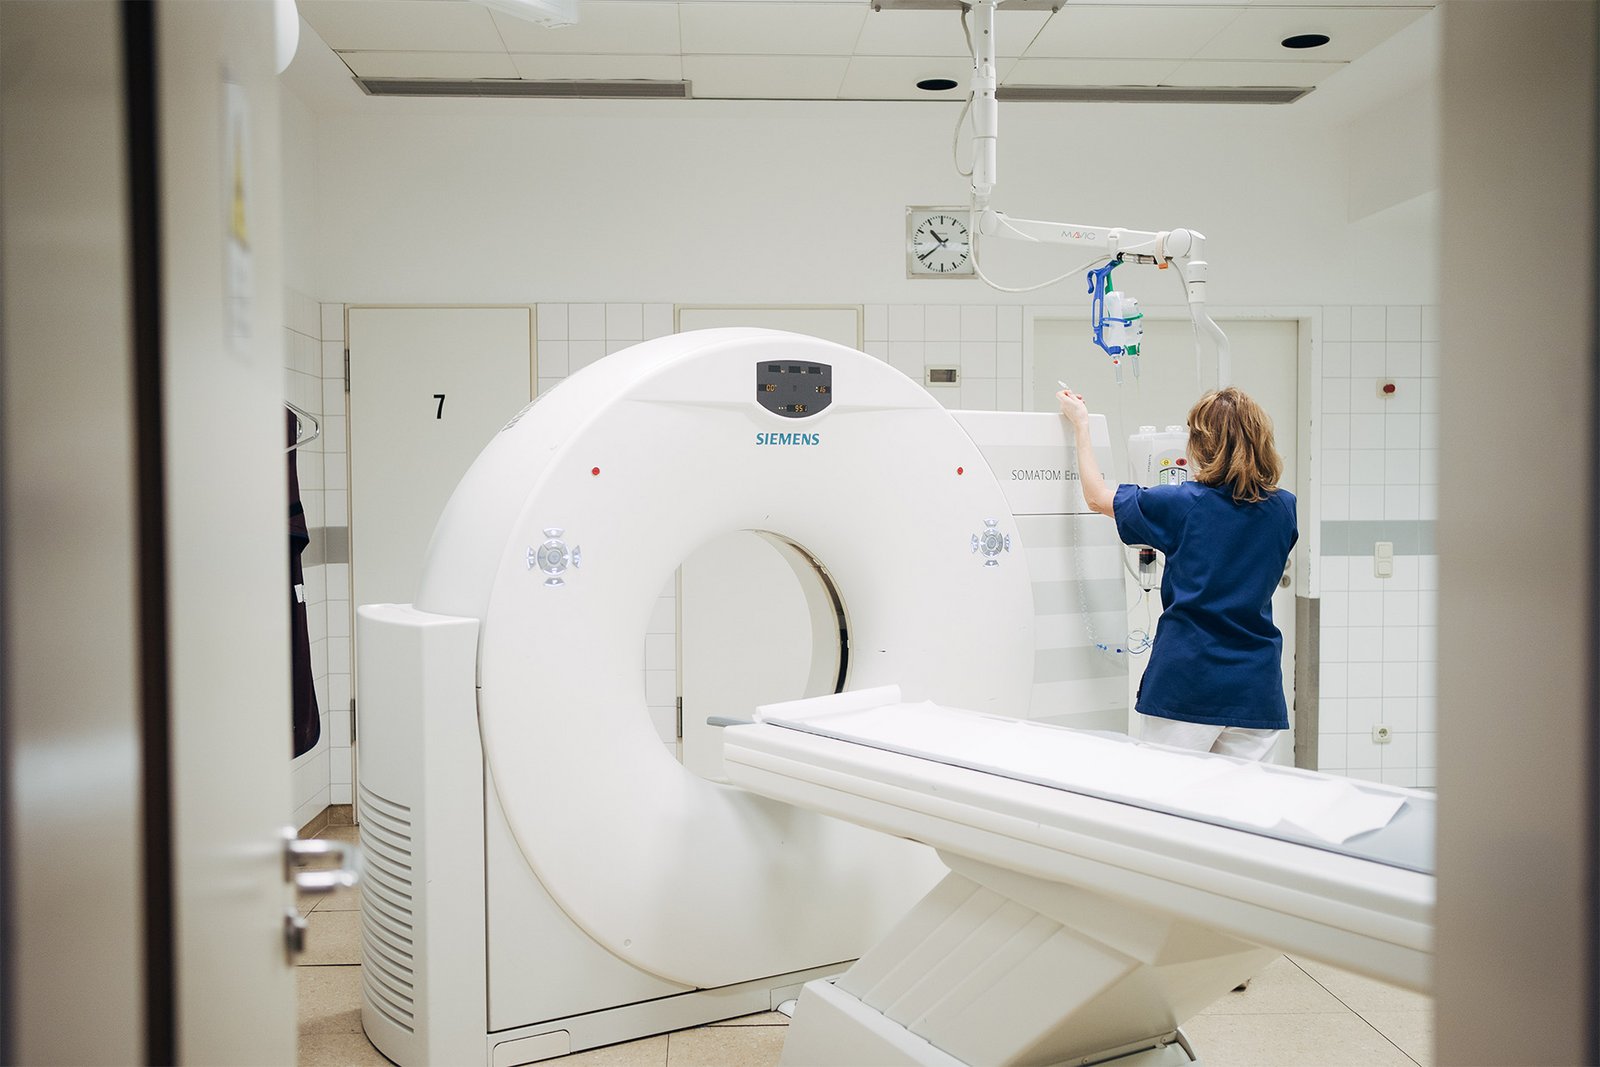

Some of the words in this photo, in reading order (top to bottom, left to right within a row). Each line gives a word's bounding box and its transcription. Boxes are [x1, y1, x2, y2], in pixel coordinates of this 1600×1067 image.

[433, 394, 446, 419] 7
[756, 433, 820, 445] SIEMENS
[1011, 469, 1061, 481] SOMATOM
